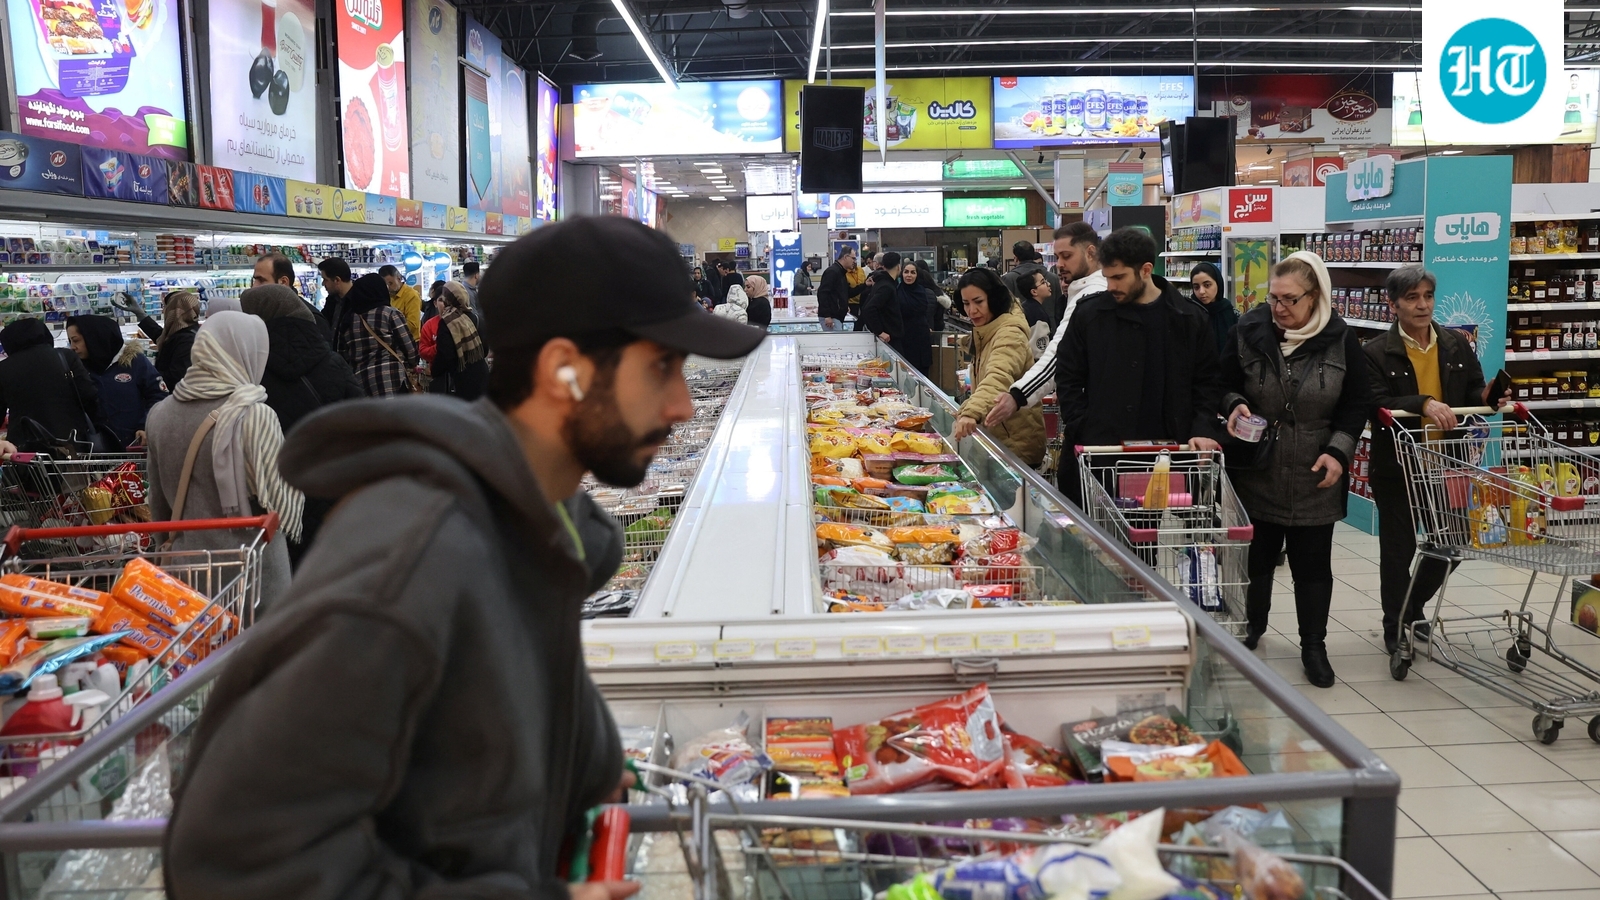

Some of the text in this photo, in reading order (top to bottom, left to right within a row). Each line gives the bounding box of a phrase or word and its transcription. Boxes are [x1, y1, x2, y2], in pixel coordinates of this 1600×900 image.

[1160, 82, 1184, 92] EFES
[928, 101, 976, 119] کالین
[1086, 101, 1105, 109] EFES
[1107, 103, 1123, 111] EFES
[25, 117, 90, 135] www.farsifood.com
[239, 113, 297, 140] خرمای مروارید سیاه
[227, 138, 238, 155] بم
[816, 131, 850, 148] HARLEY'S
[275, 149, 281, 164] از
[281, 149, 305, 166] محصولی
[1445, 216, 1490, 240] هایلی
[1431, 255, 1457, 264] شاهکار
[1457, 255, 1468, 263] یک
[128, 584, 176, 618] Parmiss
